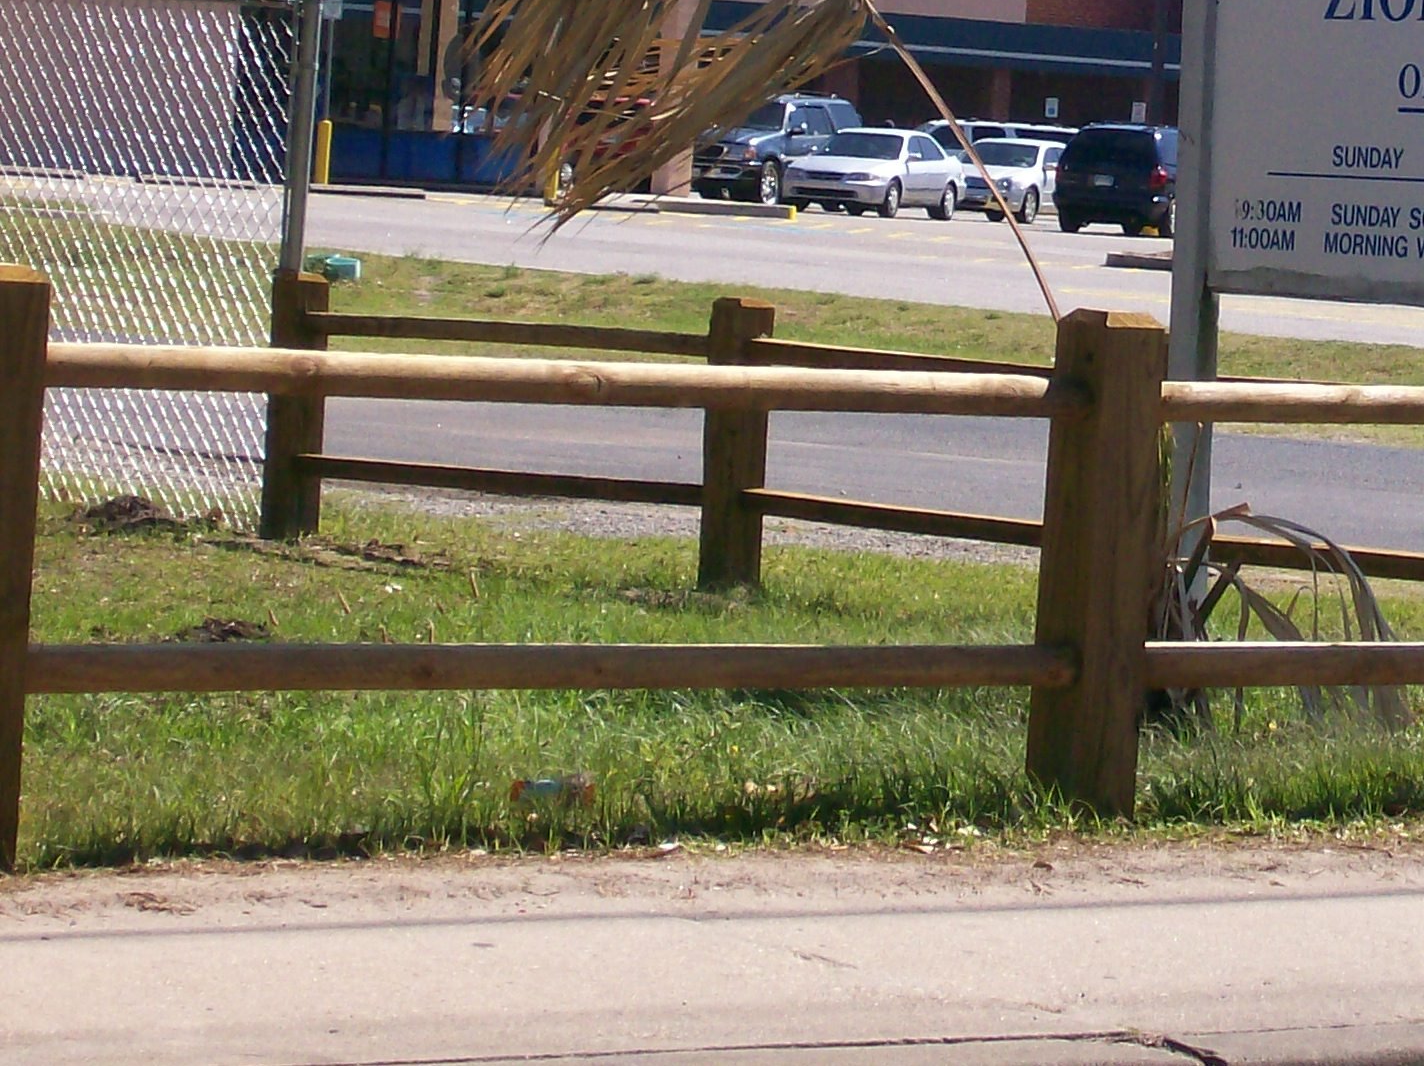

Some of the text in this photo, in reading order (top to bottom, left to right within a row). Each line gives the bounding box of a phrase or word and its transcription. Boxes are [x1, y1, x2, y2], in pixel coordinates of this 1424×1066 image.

[1332, 145, 1404, 169] SUNDAY
[1331, 203, 1401, 229] SUNDAY
[1231, 226, 1295, 251] 11:00AM
[1324, 232, 1408, 259] MORNING
